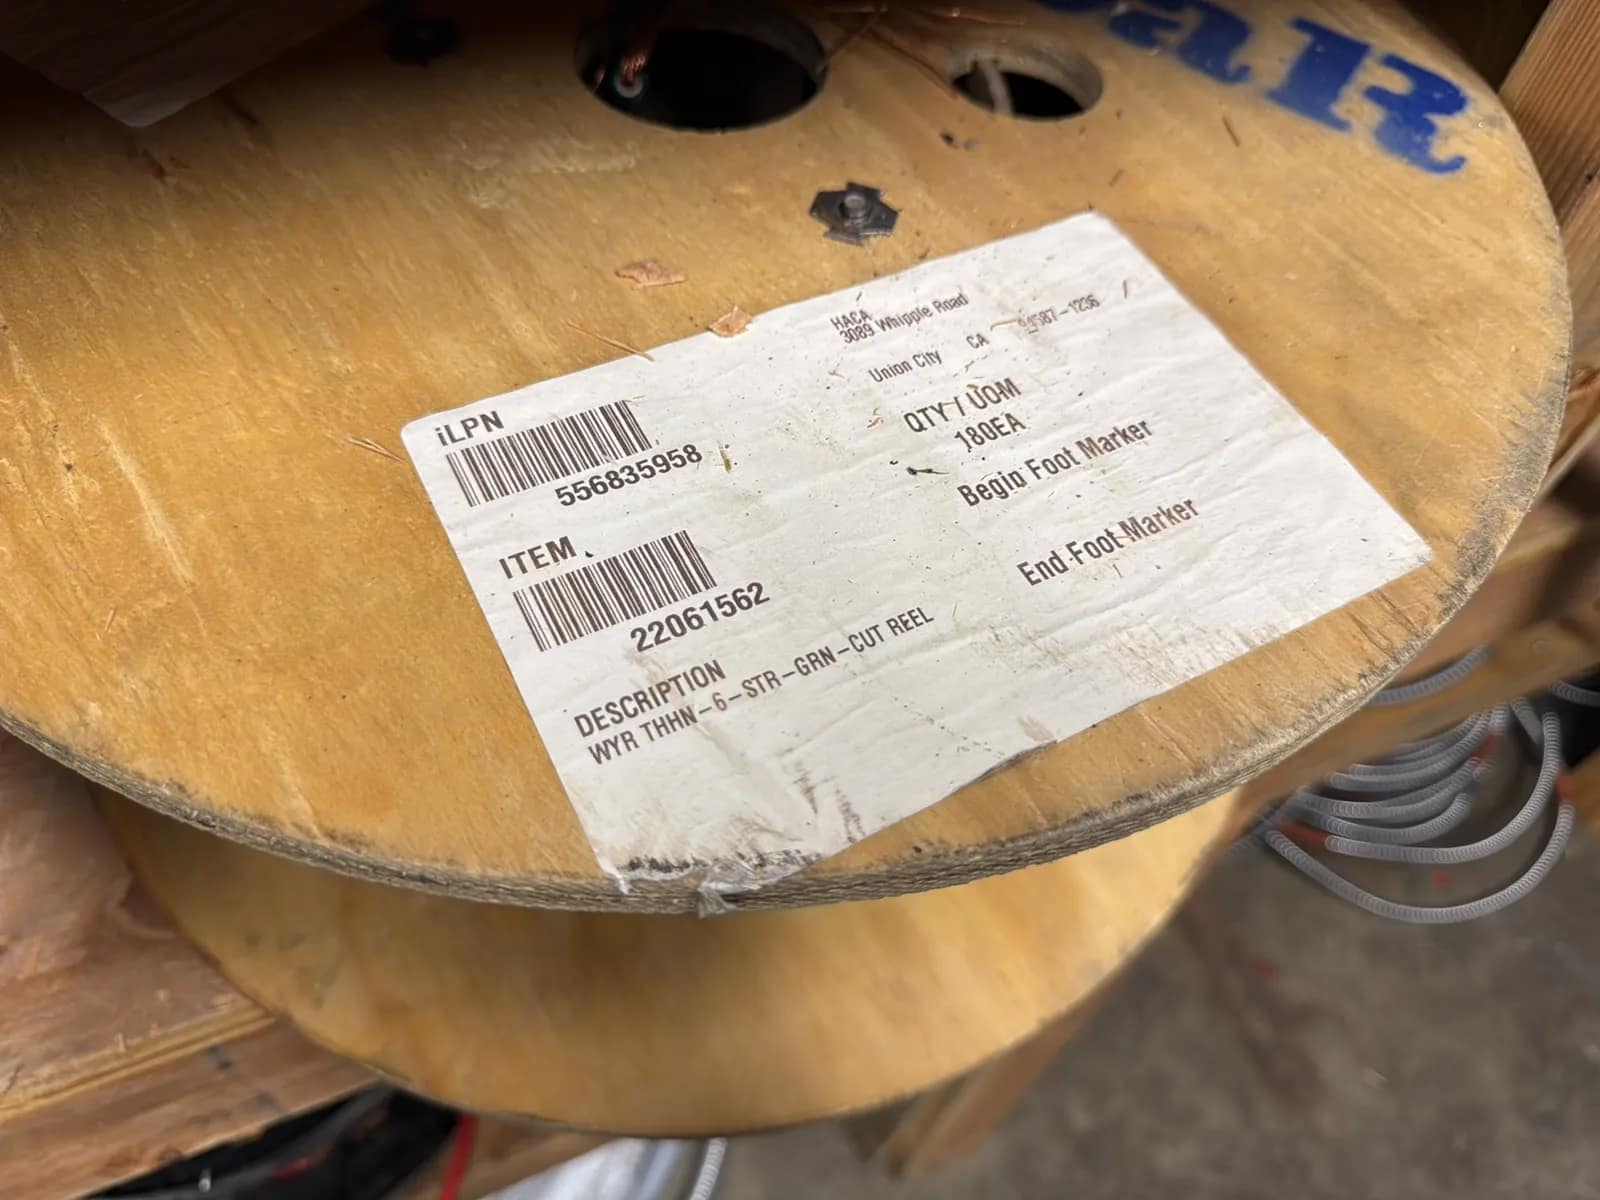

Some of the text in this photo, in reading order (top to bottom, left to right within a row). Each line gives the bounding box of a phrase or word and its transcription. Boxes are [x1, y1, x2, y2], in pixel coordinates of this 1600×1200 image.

[830, 309, 872, 331] HACA
[839, 292, 969, 344] 3089 Whipple Road
[868, 361, 912, 383] Union
[912, 350, 943, 370] City
[966, 333, 990, 349] CA
[434, 410, 504, 446] iLPN
[903, 401, 949, 433] QTY
[965, 377, 1022, 410] UOM
[954, 412, 1027, 450] 180EA
[555, 444, 703, 506] 556835958
[957, 420, 1153, 507] Begin Foot Marker
[499, 536, 577, 579] ITEM
[1017, 499, 1199, 586] End Foot Marker
[630, 582, 770, 652] 22061562
[574, 659, 726, 738] DESCRIPTION
[588, 730, 640, 765] WYR
[889, 607, 934, 637] REEL
